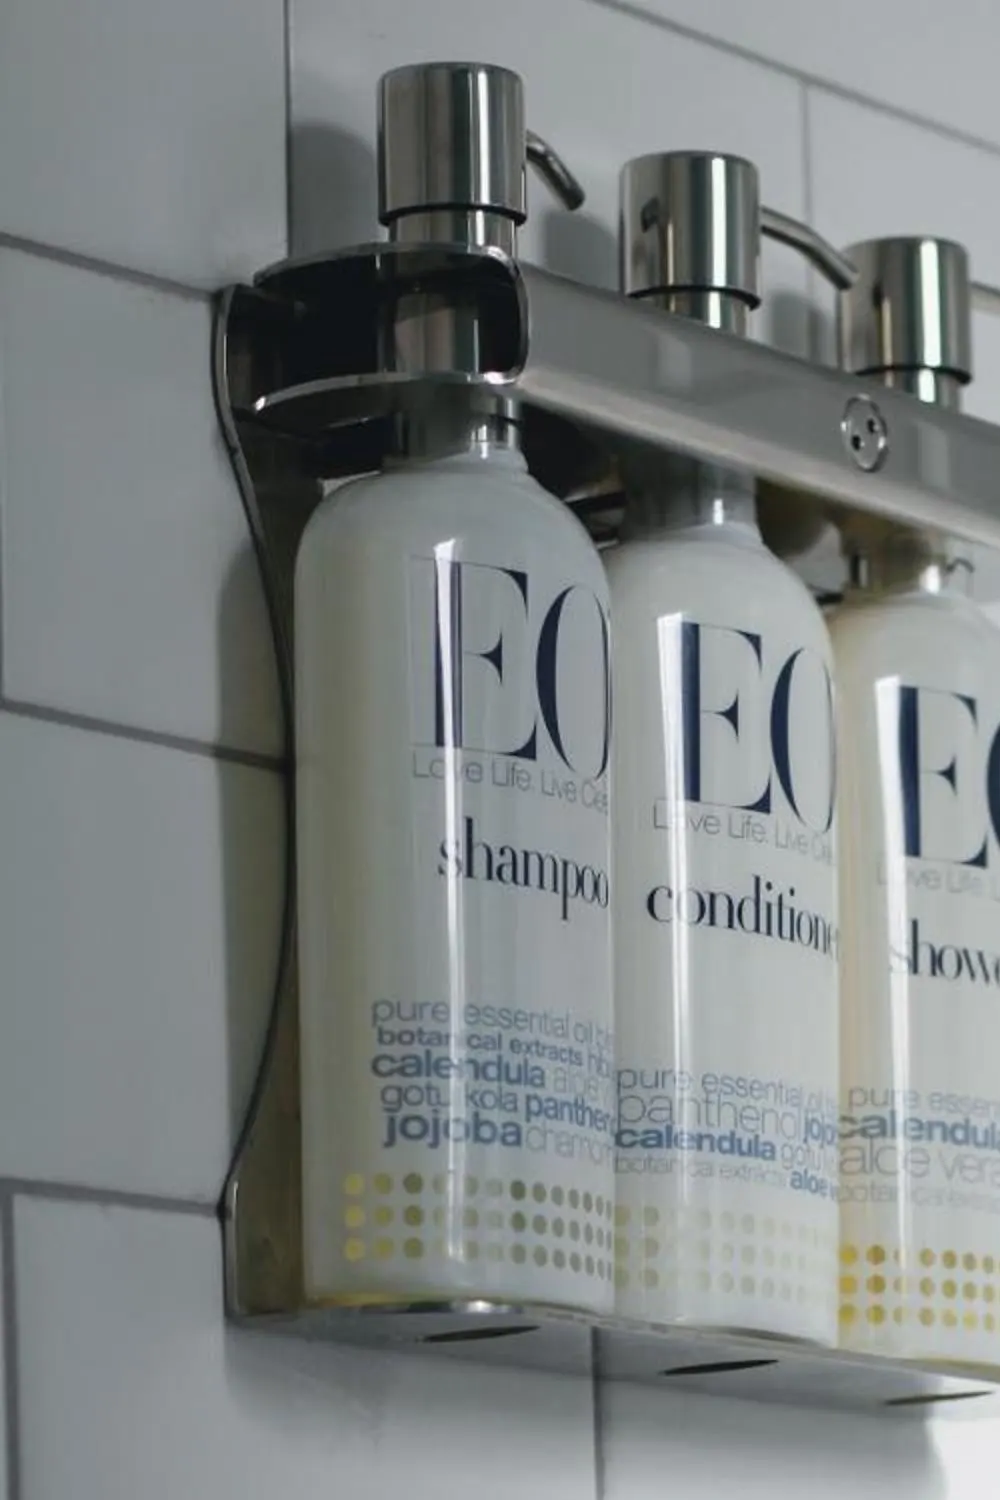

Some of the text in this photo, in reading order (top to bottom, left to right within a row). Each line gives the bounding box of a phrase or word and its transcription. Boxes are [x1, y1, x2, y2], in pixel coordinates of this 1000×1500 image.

[408, 554, 613, 781] EO
[676, 620, 838, 834] EO
[412, 750, 484, 784] Loe
[652, 803, 722, 836] Lve
[370, 999, 450, 1028] pure
[376, 1026, 502, 1054] botancal
[370, 1049, 546, 1089] calendula
[465, 1085, 520, 1114] kola
[382, 1108, 523, 1150] jojoba
[614, 1124, 777, 1162] calendula
[615, 1155, 715, 1179] botancal
